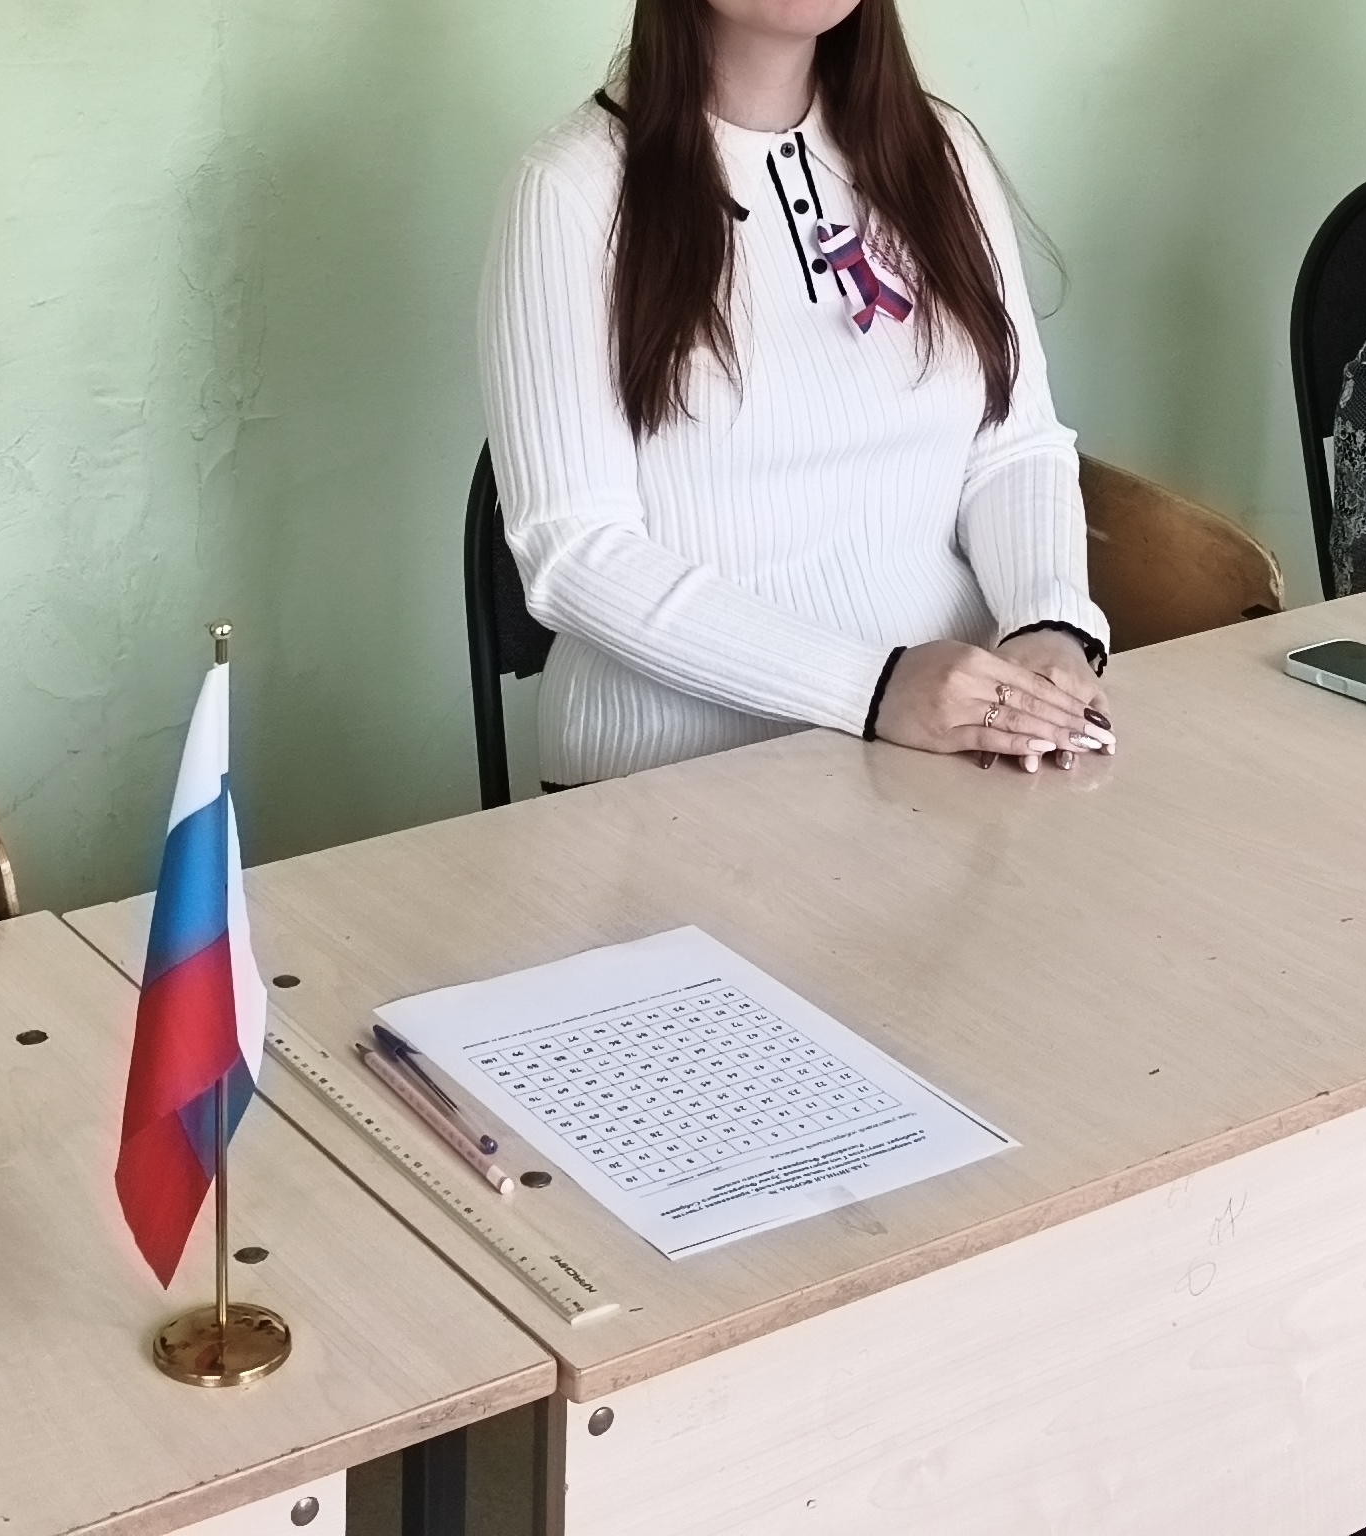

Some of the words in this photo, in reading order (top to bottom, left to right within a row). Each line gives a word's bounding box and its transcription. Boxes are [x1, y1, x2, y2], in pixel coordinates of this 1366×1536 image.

[788, 1036, 800, 1044] 51
[763, 1044, 776, 1052] 52
[598, 1059, 610, 1067] 77
[839, 1072, 852, 1081] 21
[629, 1083, 641, 1092] 57
[857, 1085, 869, 1093] 11
[831, 1093, 845, 1101] 12
[733, 1105, 747, 1113] 25
[679, 1121, 692, 1130] 27
[750, 1118, 764, 1126] 15
[696, 1135, 708, 1143] 17
